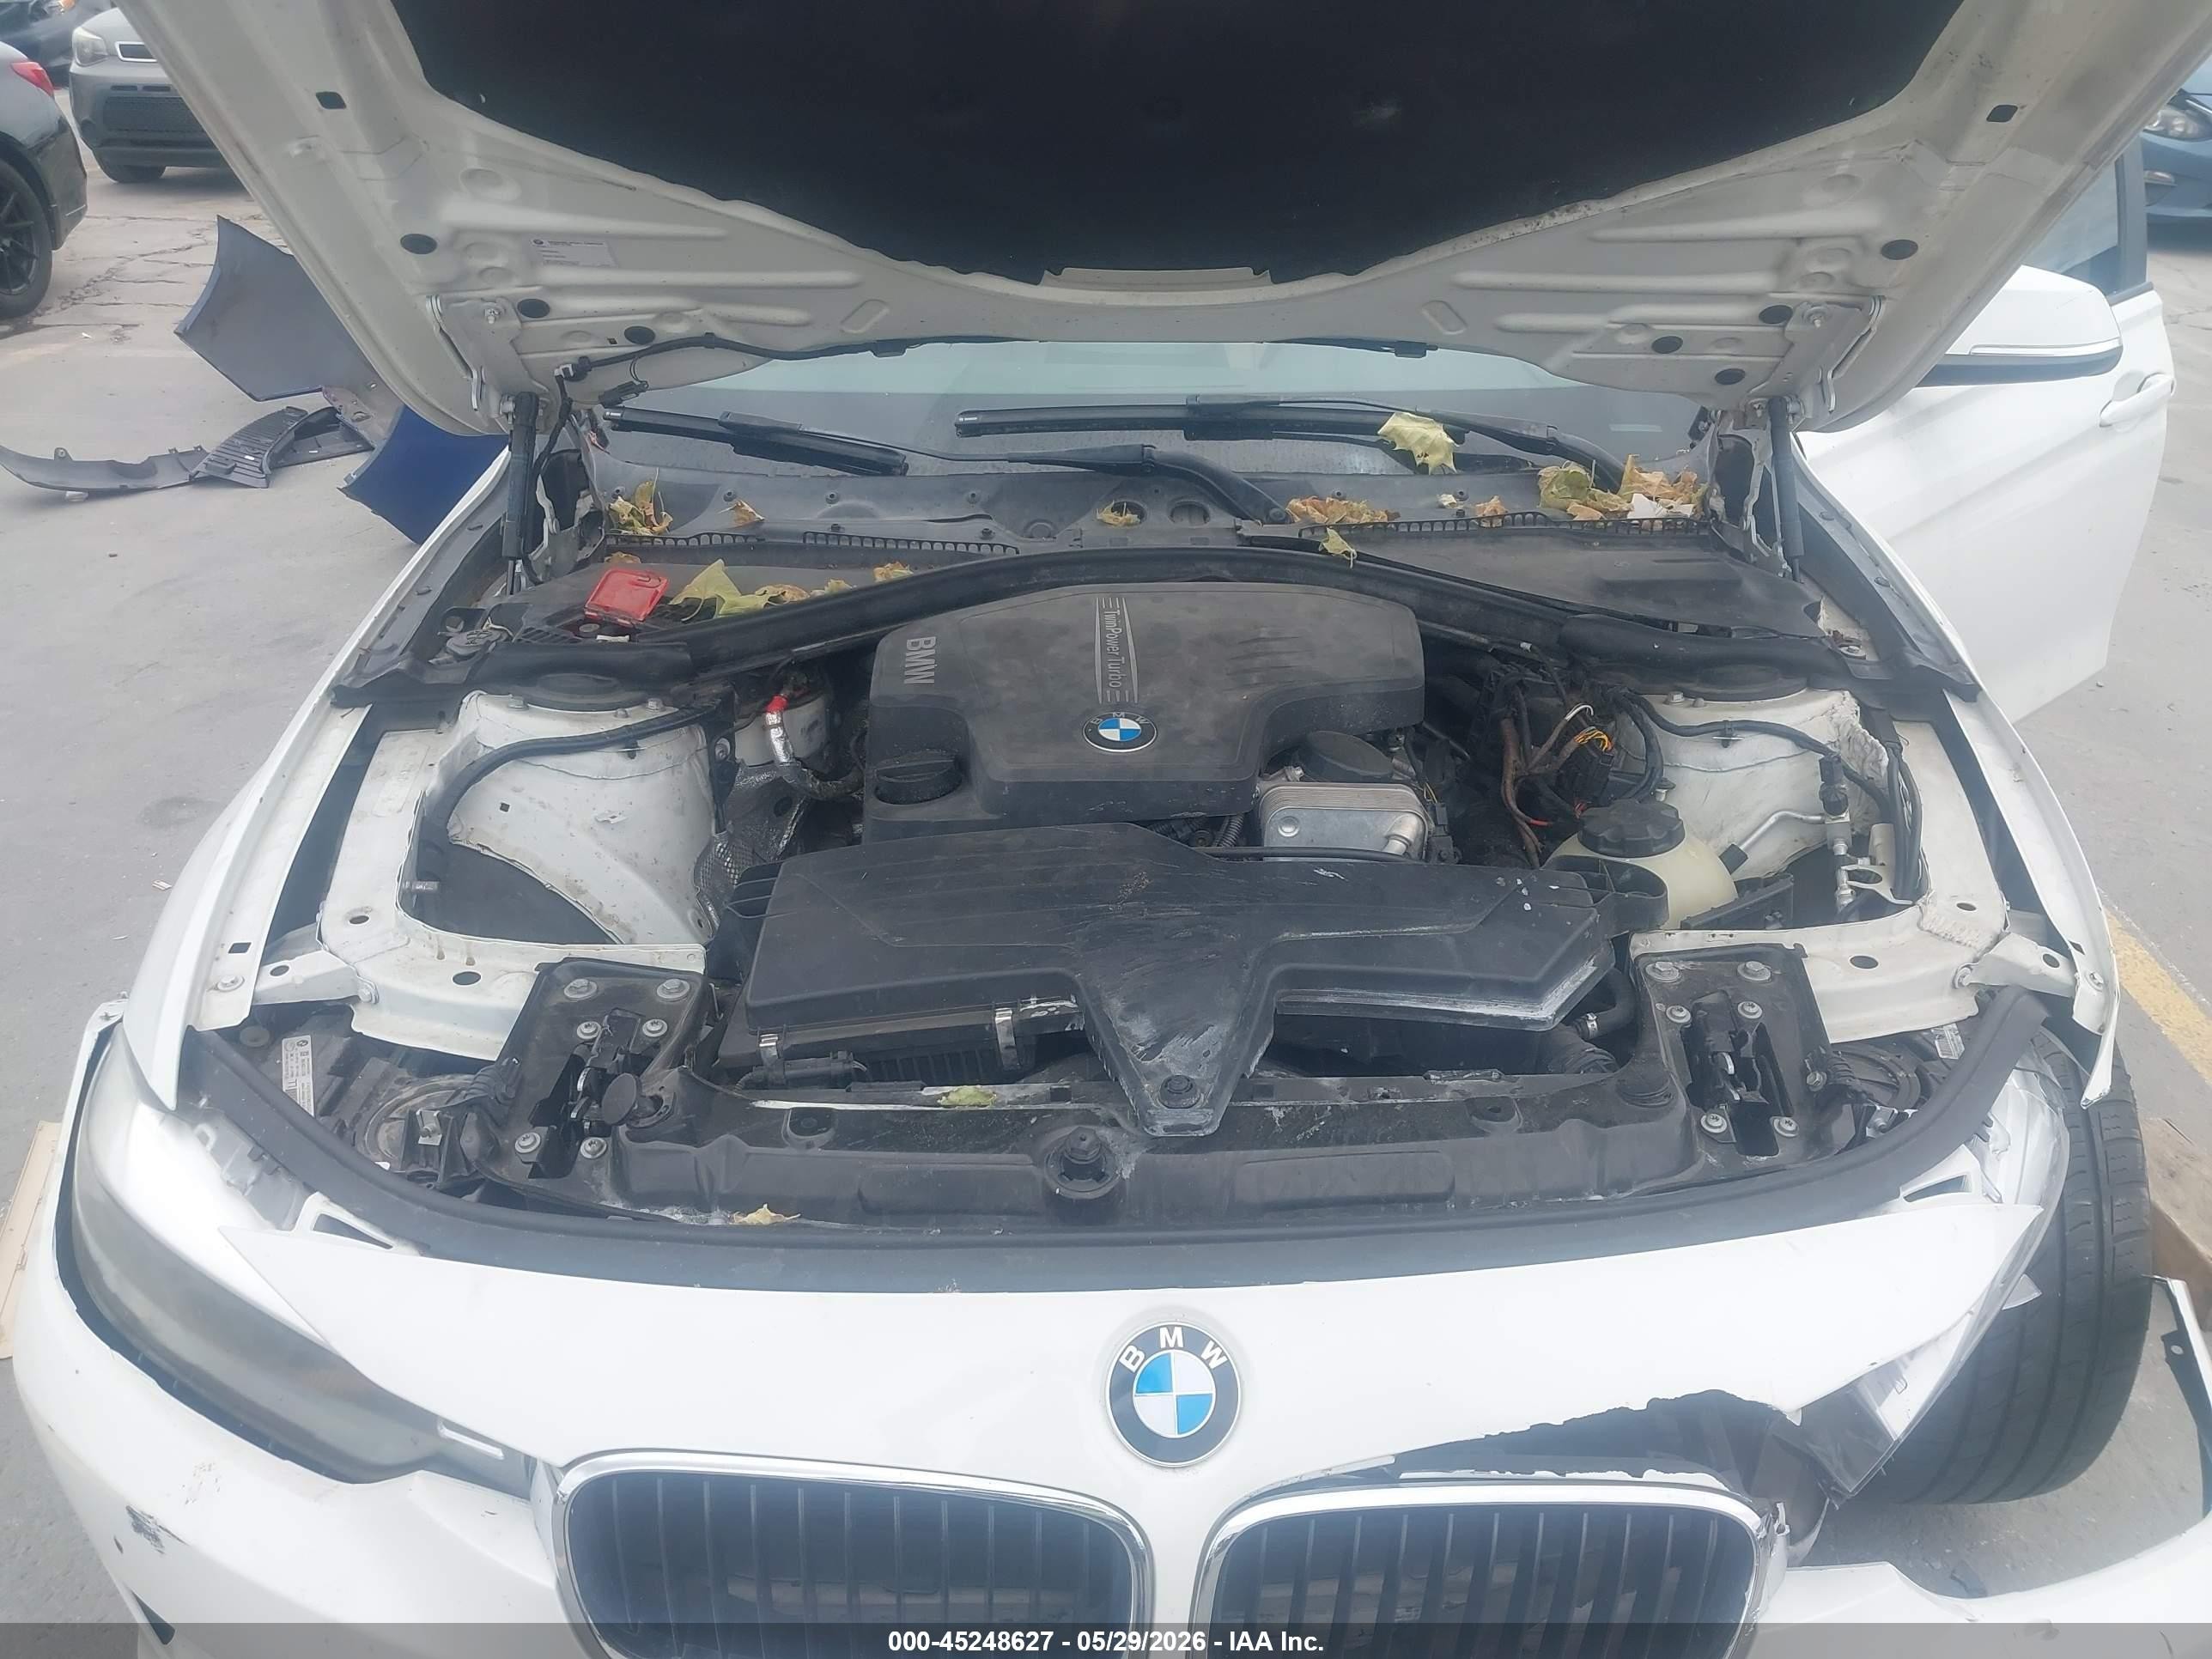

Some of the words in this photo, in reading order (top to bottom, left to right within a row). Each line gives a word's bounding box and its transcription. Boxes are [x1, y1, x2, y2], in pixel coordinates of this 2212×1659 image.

[1103, 610, 1122, 654] TwinPower
[904, 636, 936, 684] BMW
[1107, 656, 1127, 688] Turbo
[1091, 711, 1151, 725] BMW
[1119, 1326, 1228, 1373] BMW
